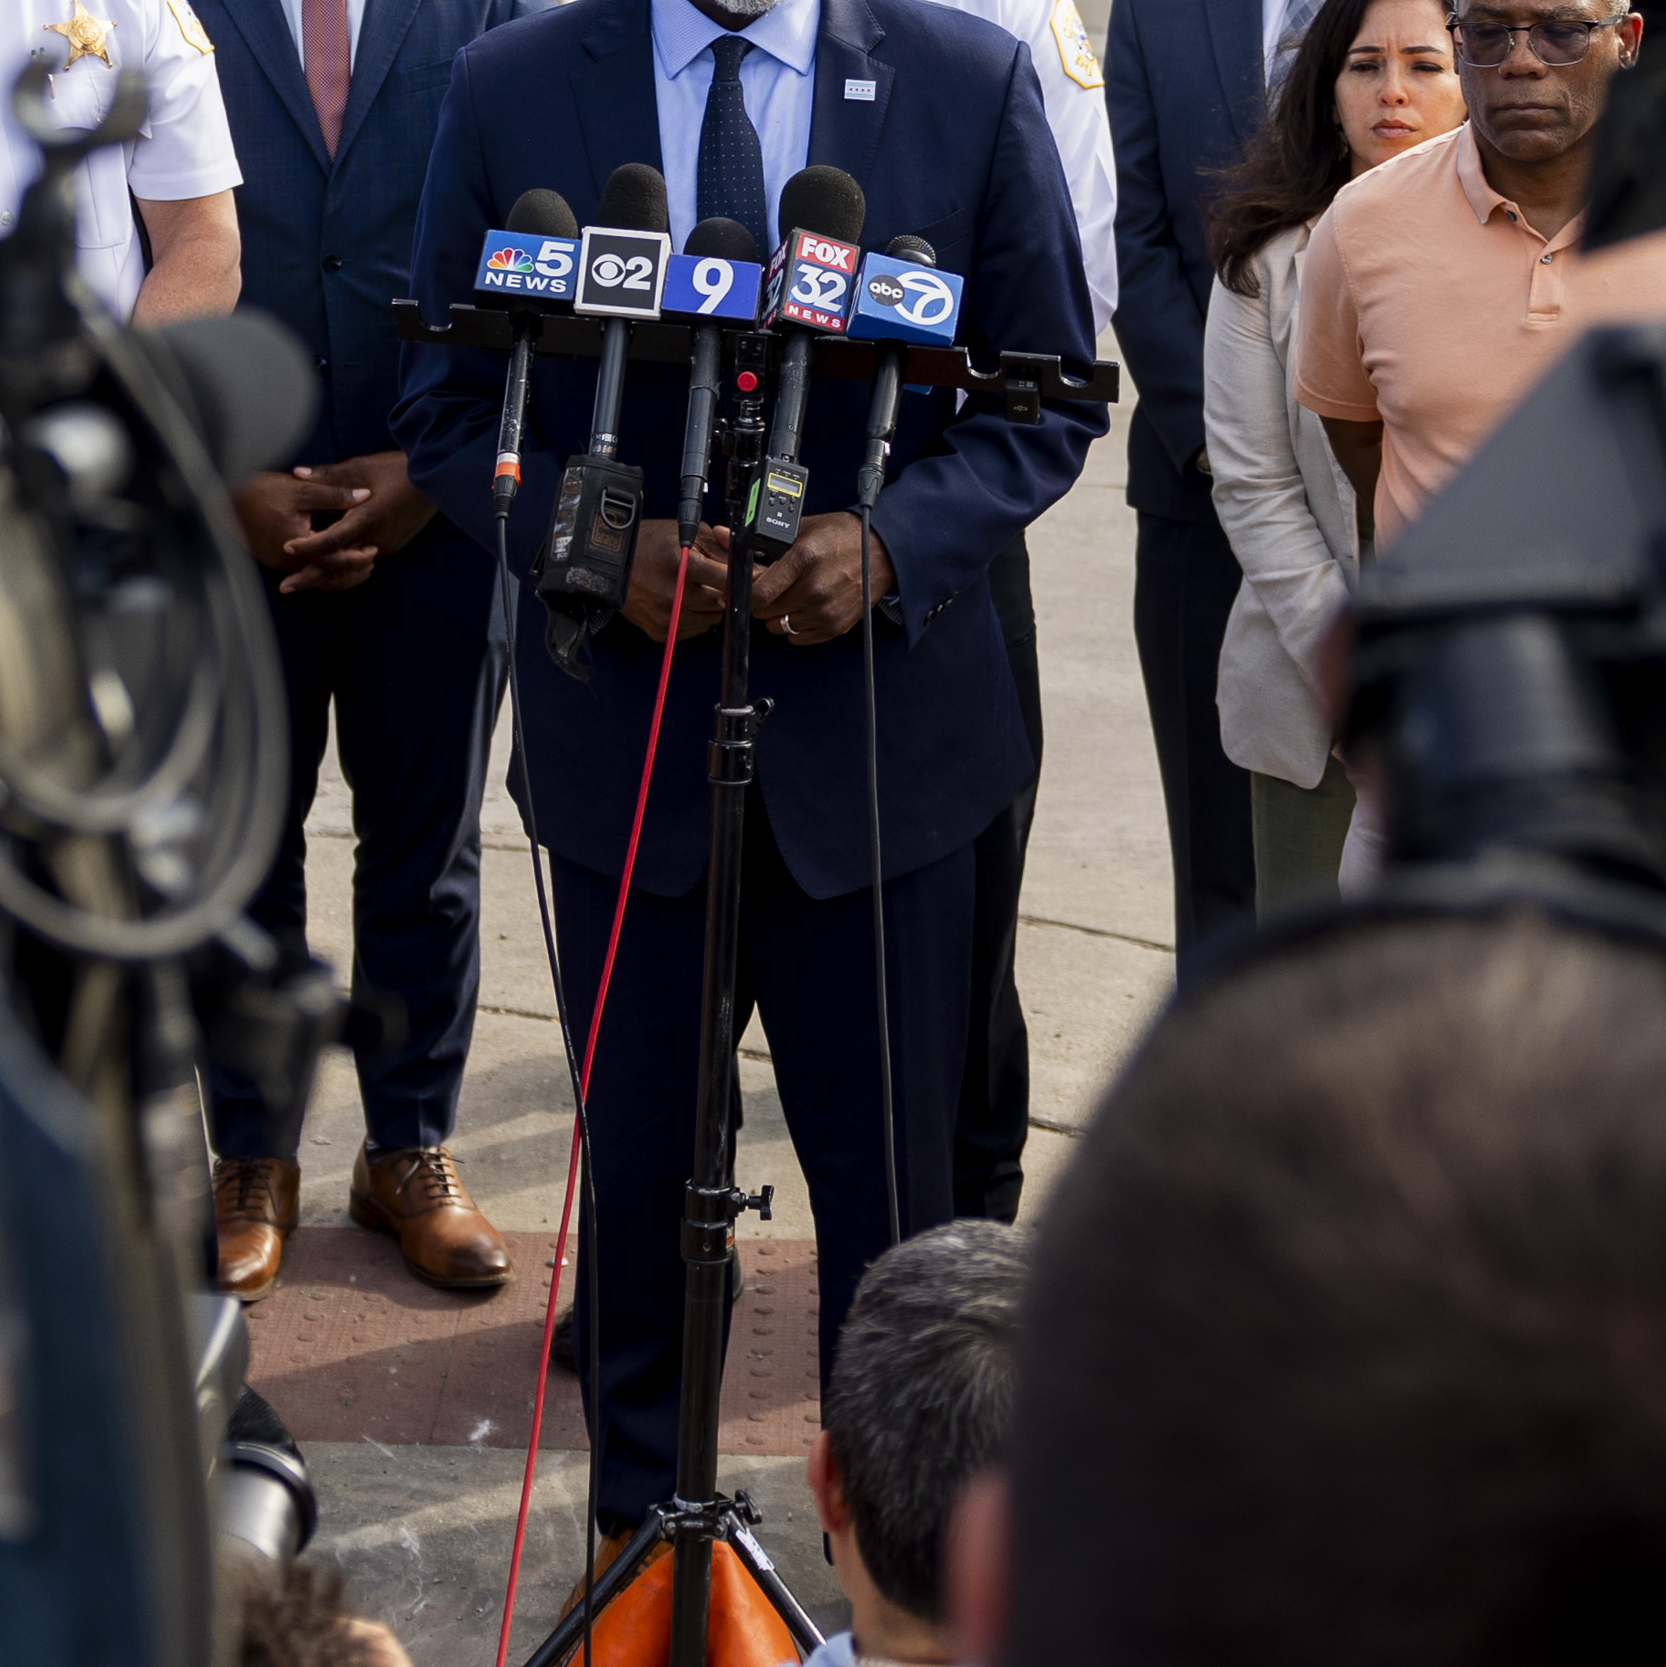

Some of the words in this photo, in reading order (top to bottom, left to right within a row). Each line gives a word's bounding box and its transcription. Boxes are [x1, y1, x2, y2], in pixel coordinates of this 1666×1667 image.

[535, 240, 575, 277] 5
[801, 236, 850, 270] FOX
[484, 272, 567, 293] NEWS
[622, 256, 653, 291] 2
[692, 257, 734, 314] 9
[791, 263, 847, 313] 32
[869, 282, 903, 299] abc
[788, 305, 841, 328] NEWS
[765, 516, 791, 529] SONY
